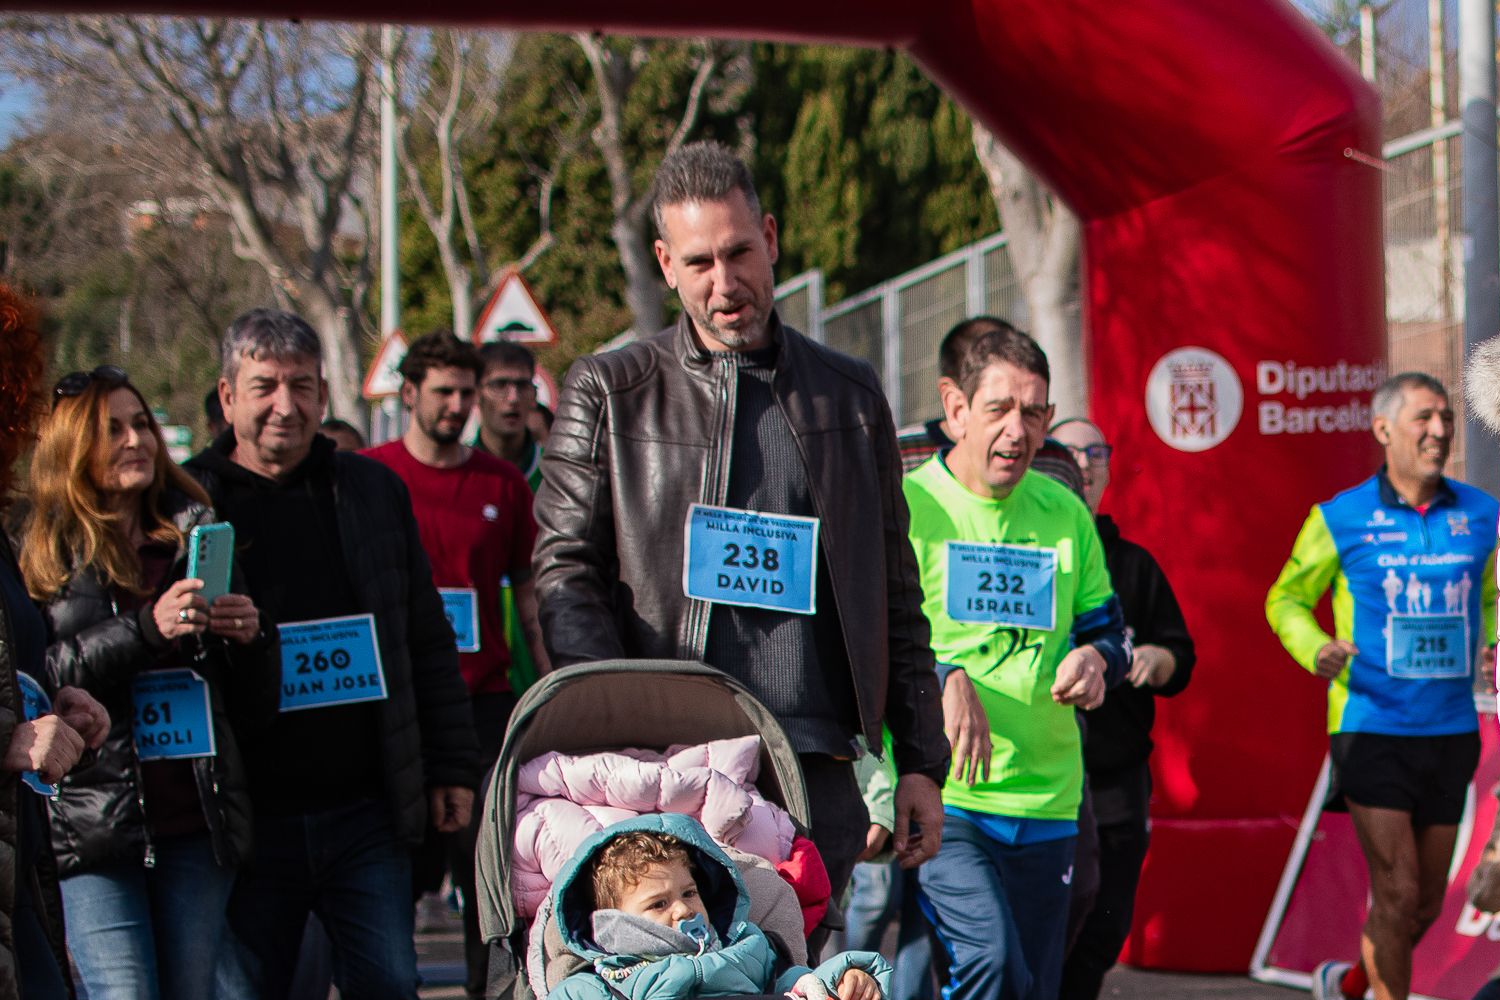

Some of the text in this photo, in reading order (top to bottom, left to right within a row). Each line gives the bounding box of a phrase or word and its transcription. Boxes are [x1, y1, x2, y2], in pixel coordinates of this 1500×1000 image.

[706, 520, 798, 541] MILLA INCLUSIVA
[723, 543, 779, 572] 238
[717, 573, 784, 595] DAVID
[977, 571, 1025, 595] 232
[967, 597, 1035, 616] ISRAEL
[1416, 637, 1447, 652] 215
[295, 649, 351, 675] 260
[283, 674, 379, 697] UAN JOSE
[135, 701, 172, 726] 61
[138, 729, 193, 747] NOLI
